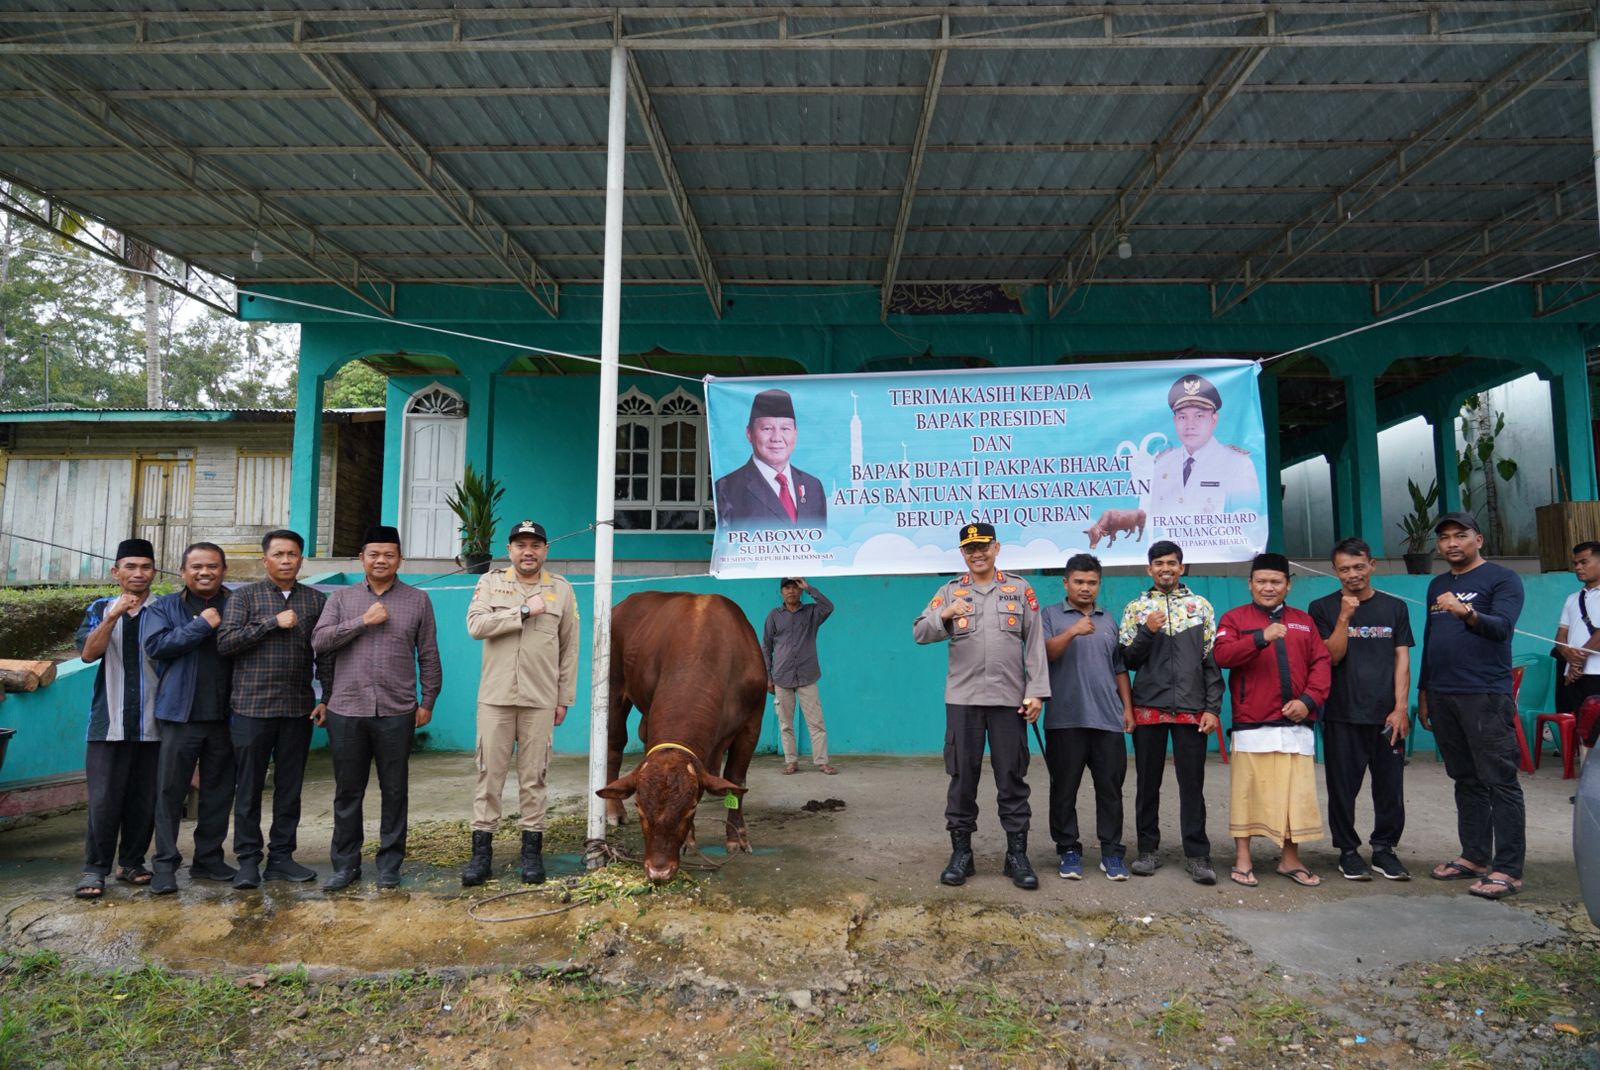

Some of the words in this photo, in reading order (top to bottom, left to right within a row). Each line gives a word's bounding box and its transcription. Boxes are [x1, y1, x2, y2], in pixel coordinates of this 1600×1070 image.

[889, 386, 1015, 405] TERIMAKASIH
[1021, 383, 1091, 402] KEPADA
[916, 412, 976, 430] BAPAK
[980, 409, 1066, 428] PRESIDEN
[972, 435, 1011, 452] DAN
[852, 463, 909, 481] BAPAK
[915, 461, 979, 479] BUPATI
[985, 458, 1054, 476] PAKPAK
[1060, 455, 1133, 474] BHARAT
[834, 488, 880, 506] ATAS
[885, 485, 972, 504] BANTUAN
[978, 480, 1150, 500] KEMASYARAKATAN
[897, 509, 966, 528] BERUPA
[971, 507, 1008, 525] SAPI
[1014, 505, 1090, 527] QURBAN
[1153, 515, 1191, 526] FRANC
[1194, 513, 1256, 525] BERNHARD
[728, 529, 822, 543] PRABOWO
[1166, 526, 1242, 538] TUMANGGOR
[740, 544, 811, 554] SUBIANTO
